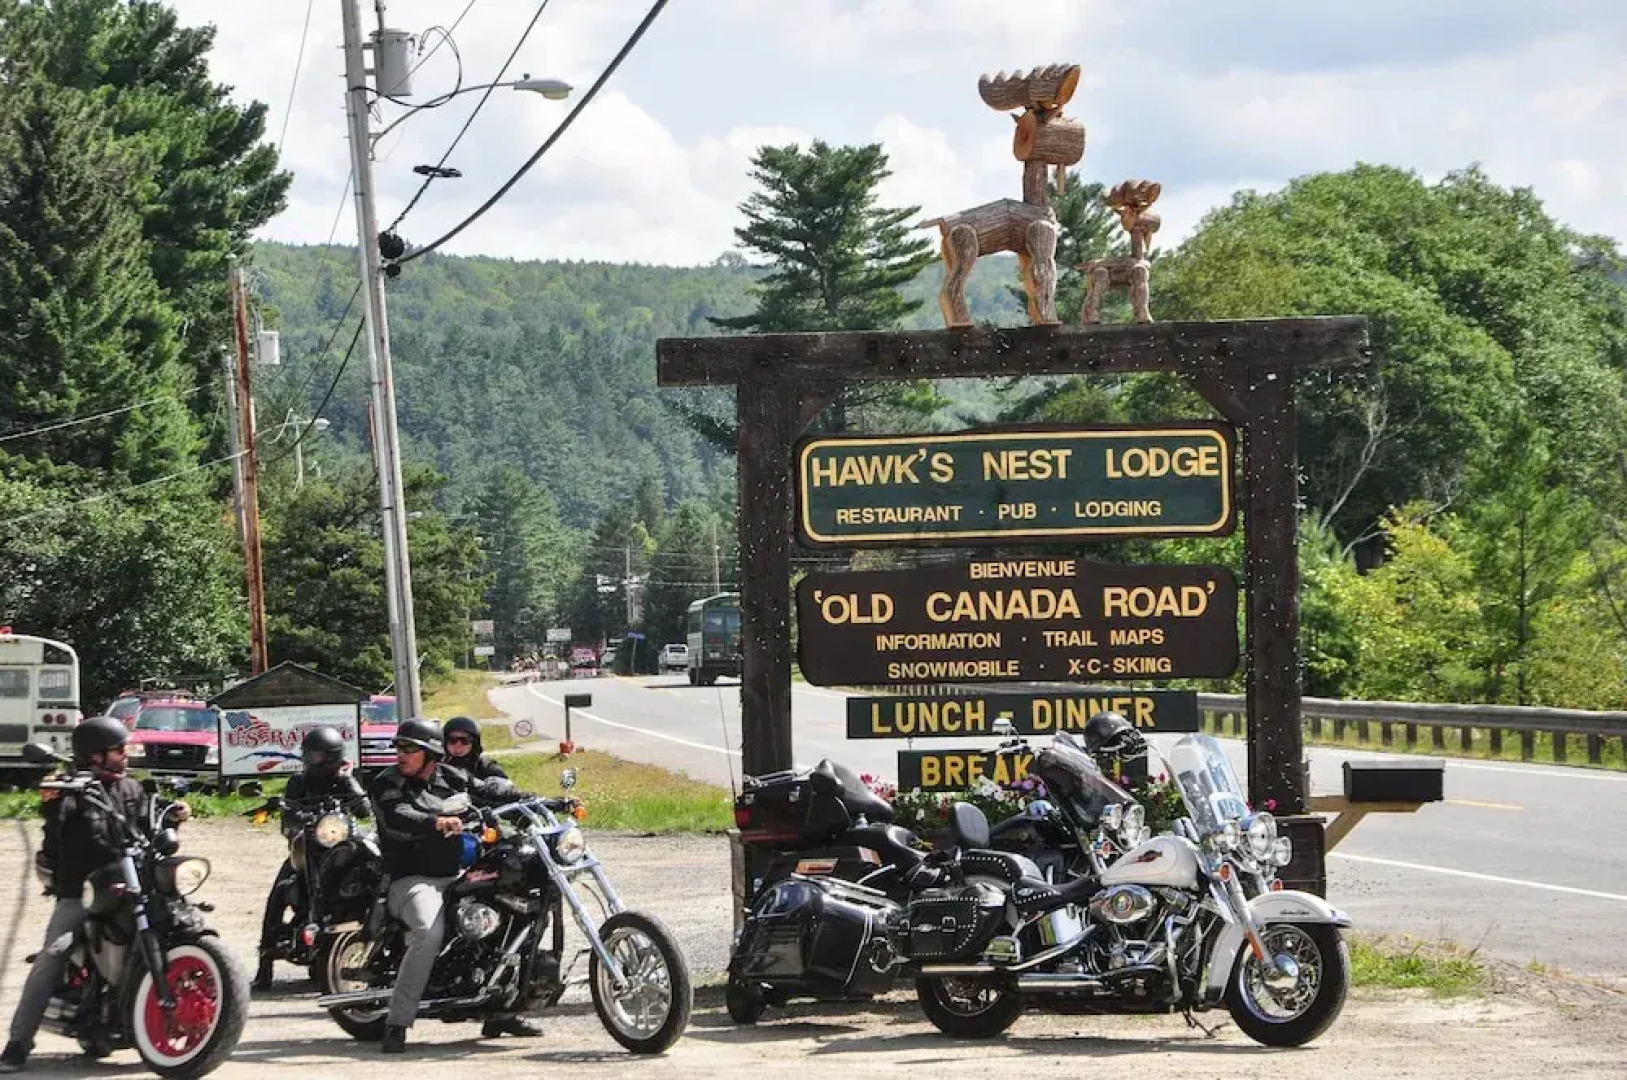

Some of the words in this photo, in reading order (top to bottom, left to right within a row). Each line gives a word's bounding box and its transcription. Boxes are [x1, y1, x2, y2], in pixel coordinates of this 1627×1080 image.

[812, 448, 954, 487] HAWK'S
[982, 449, 1072, 480] NEST
[1105, 446, 1219, 479] LODGE
[836, 506, 962, 524] RESTAURANT
[998, 502, 1037, 520] PUB
[1075, 501, 1162, 518] LODGING
[970, 560, 1076, 579] BIENVENUE
[926, 588, 1081, 622] CANADA
[876, 632, 1001, 651] INFORMATION
[1042, 630, 1098, 647] TRAIL
[1110, 628, 1164, 646] MAPS
[888, 659, 1019, 678] SNOWMOBILE
[872, 700, 985, 733] LUNCH
